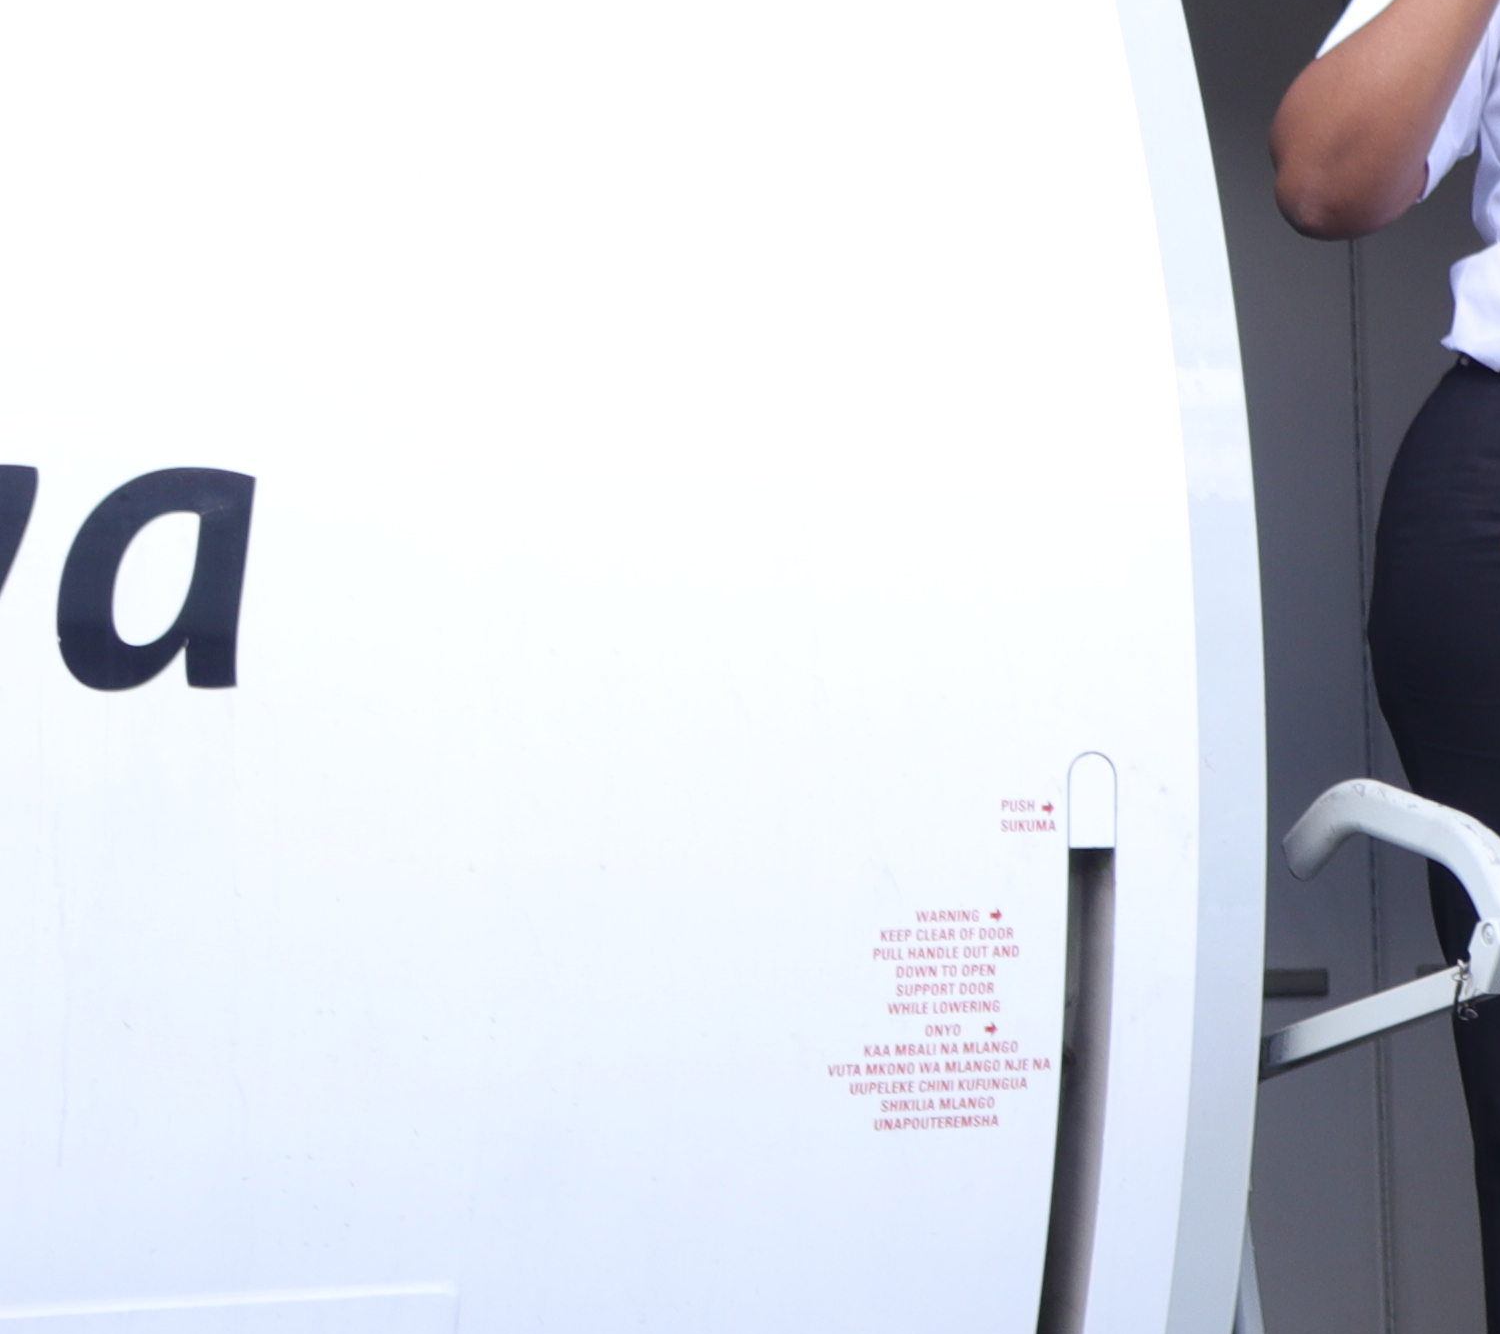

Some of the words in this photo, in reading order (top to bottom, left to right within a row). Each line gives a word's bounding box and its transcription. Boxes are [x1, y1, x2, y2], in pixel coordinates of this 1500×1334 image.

[1001, 799, 1035, 813] PUSH
[1000, 818, 1057, 833] SUKUMA
[916, 910, 979, 923] WARNING
[880, 929, 912, 942] KEEP
[916, 929, 955, 941] CLEAR
[960, 928, 975, 941] OF
[979, 927, 1014, 940] DOOR
[873, 948, 903, 960] PULL
[908, 947, 958, 960] HANDLE
[964, 946, 988, 959] OUT
[992, 945, 1019, 958] AND
[897, 965, 937, 978] DOWN
[942, 965, 957, 977] TO
[962, 964, 995, 977] OPEN
[897, 983, 955, 996] SUPPORT
[960, 982, 994, 995] DOOR
[888, 1002, 928, 1015] WHILE
[933, 1000, 1000, 1014] LOWERING
[925, 1024, 961, 1037] ONYO
[864, 1045, 890, 1058] KAA
[895, 1043, 936, 1056] MBALI
[940, 1043, 958, 1055] NA
[963, 1041, 1018, 1054] MLANGO
[828, 1064, 861, 1077] VUTA
[866, 1063, 914, 1076] MKONO
[919, 1062, 940, 1074] WA
[945, 1060, 1000, 1073] MLANGO
[1005, 1059, 1029, 1071] NJE
[1033, 1058, 1051, 1071] NA
[919, 1080, 954, 1093] CHINI
[958, 1077, 1027, 1092] KUFUNGUA
[882, 1099, 934, 1112] SHIKILIA
[940, 1097, 994, 1111] MLANGO
